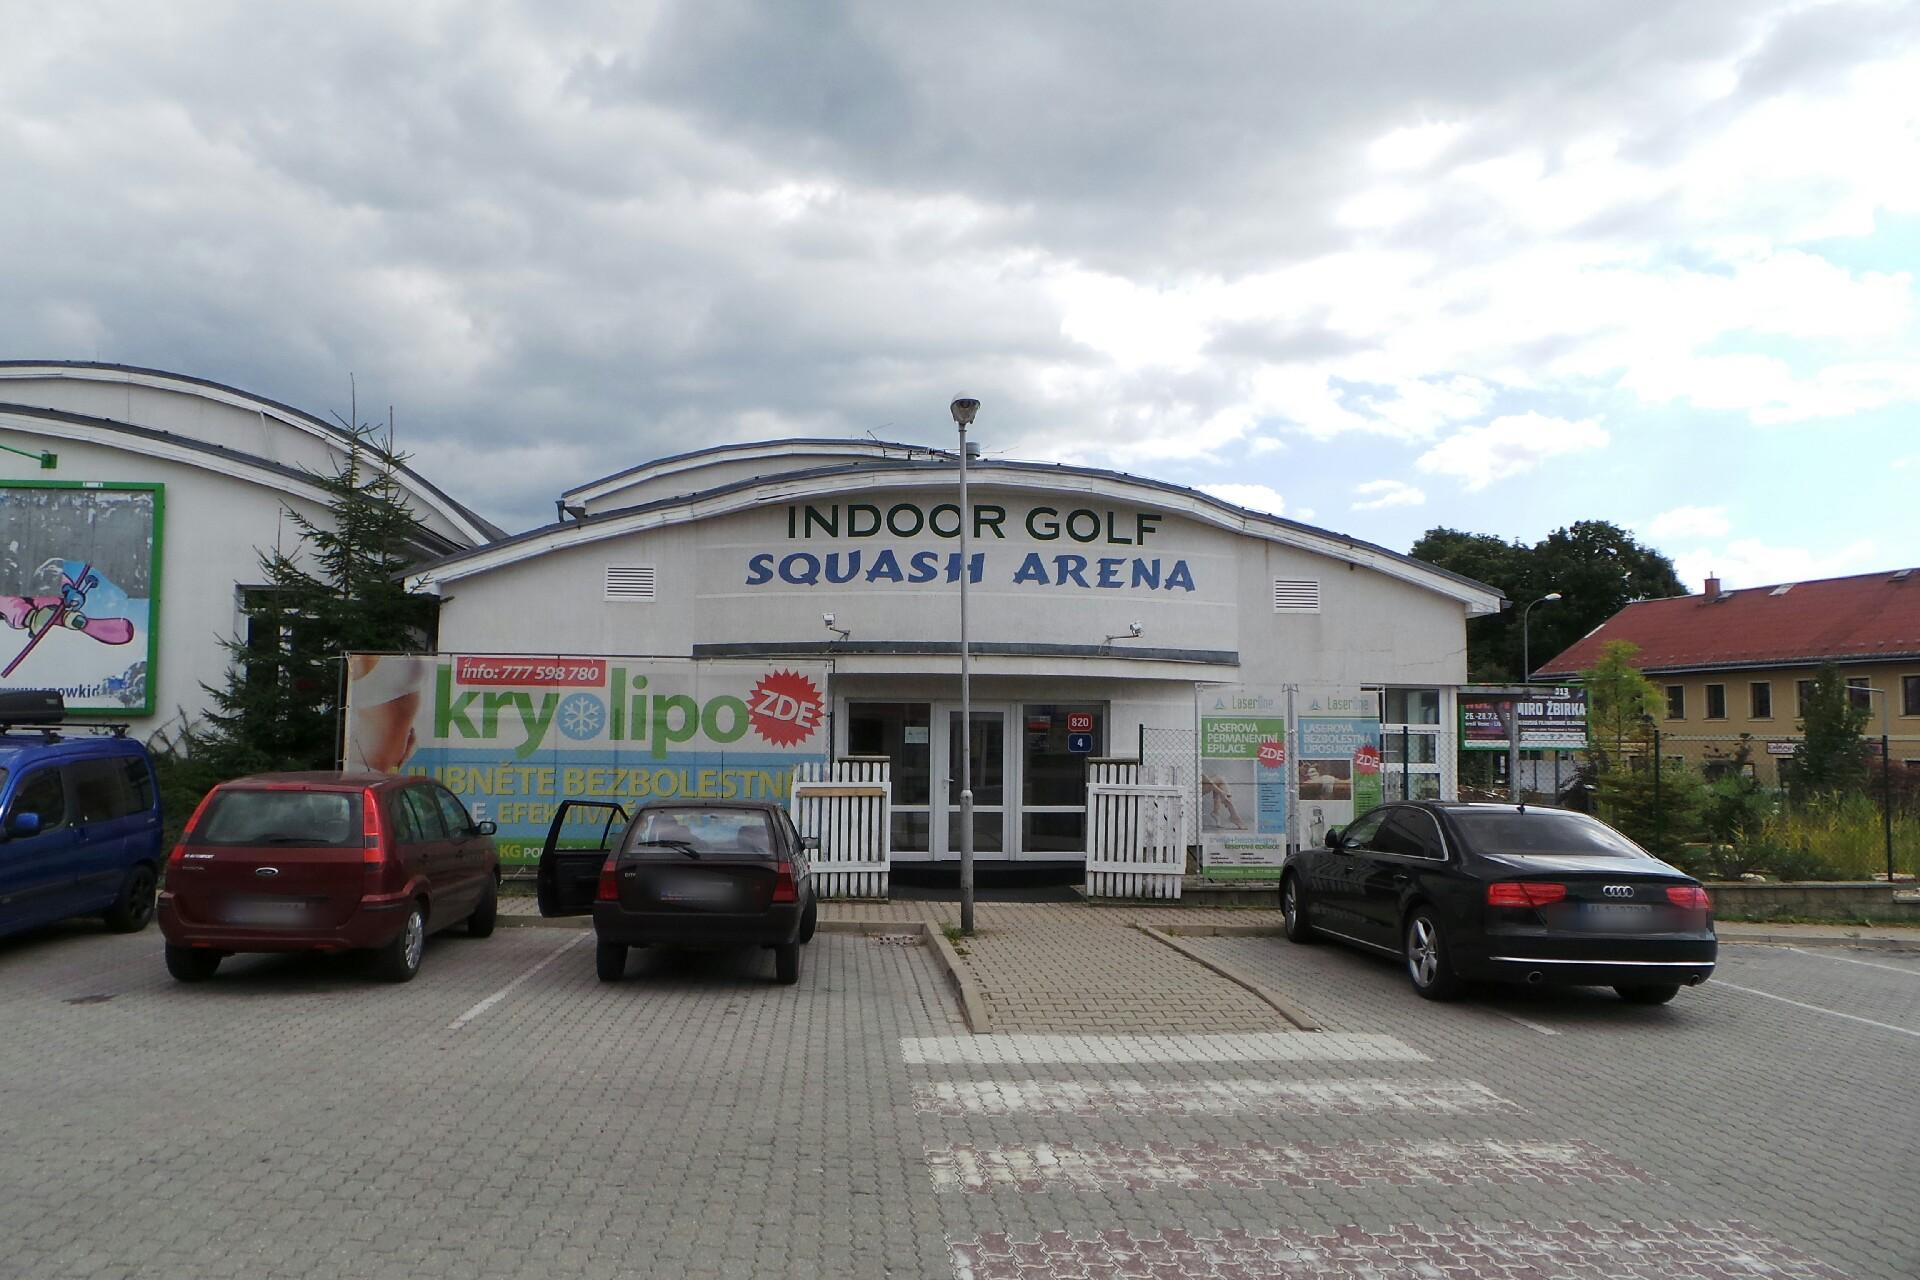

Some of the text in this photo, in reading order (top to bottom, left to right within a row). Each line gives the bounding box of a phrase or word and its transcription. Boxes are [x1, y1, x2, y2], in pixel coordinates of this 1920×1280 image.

[788, 504, 1163, 545] INDOOR GOLF
[745, 549, 1196, 593] SQUASH ARENA
[461, 664, 599, 681] info: 777 598 780
[754, 689, 816, 729] ZDE
[1546, 700, 1586, 716] ŽBIRKA
[1071, 717, 1089, 727] 820
[1207, 722, 1258, 733] LASEROVÁ
[1077, 738, 1083, 747] 4
[1207, 733, 1278, 743] PERMANENTNÍ
[1207, 744, 1247, 753] EPILACE
[1259, 747, 1284, 760] ZDE
[1356, 754, 1380, 768] ZDE
